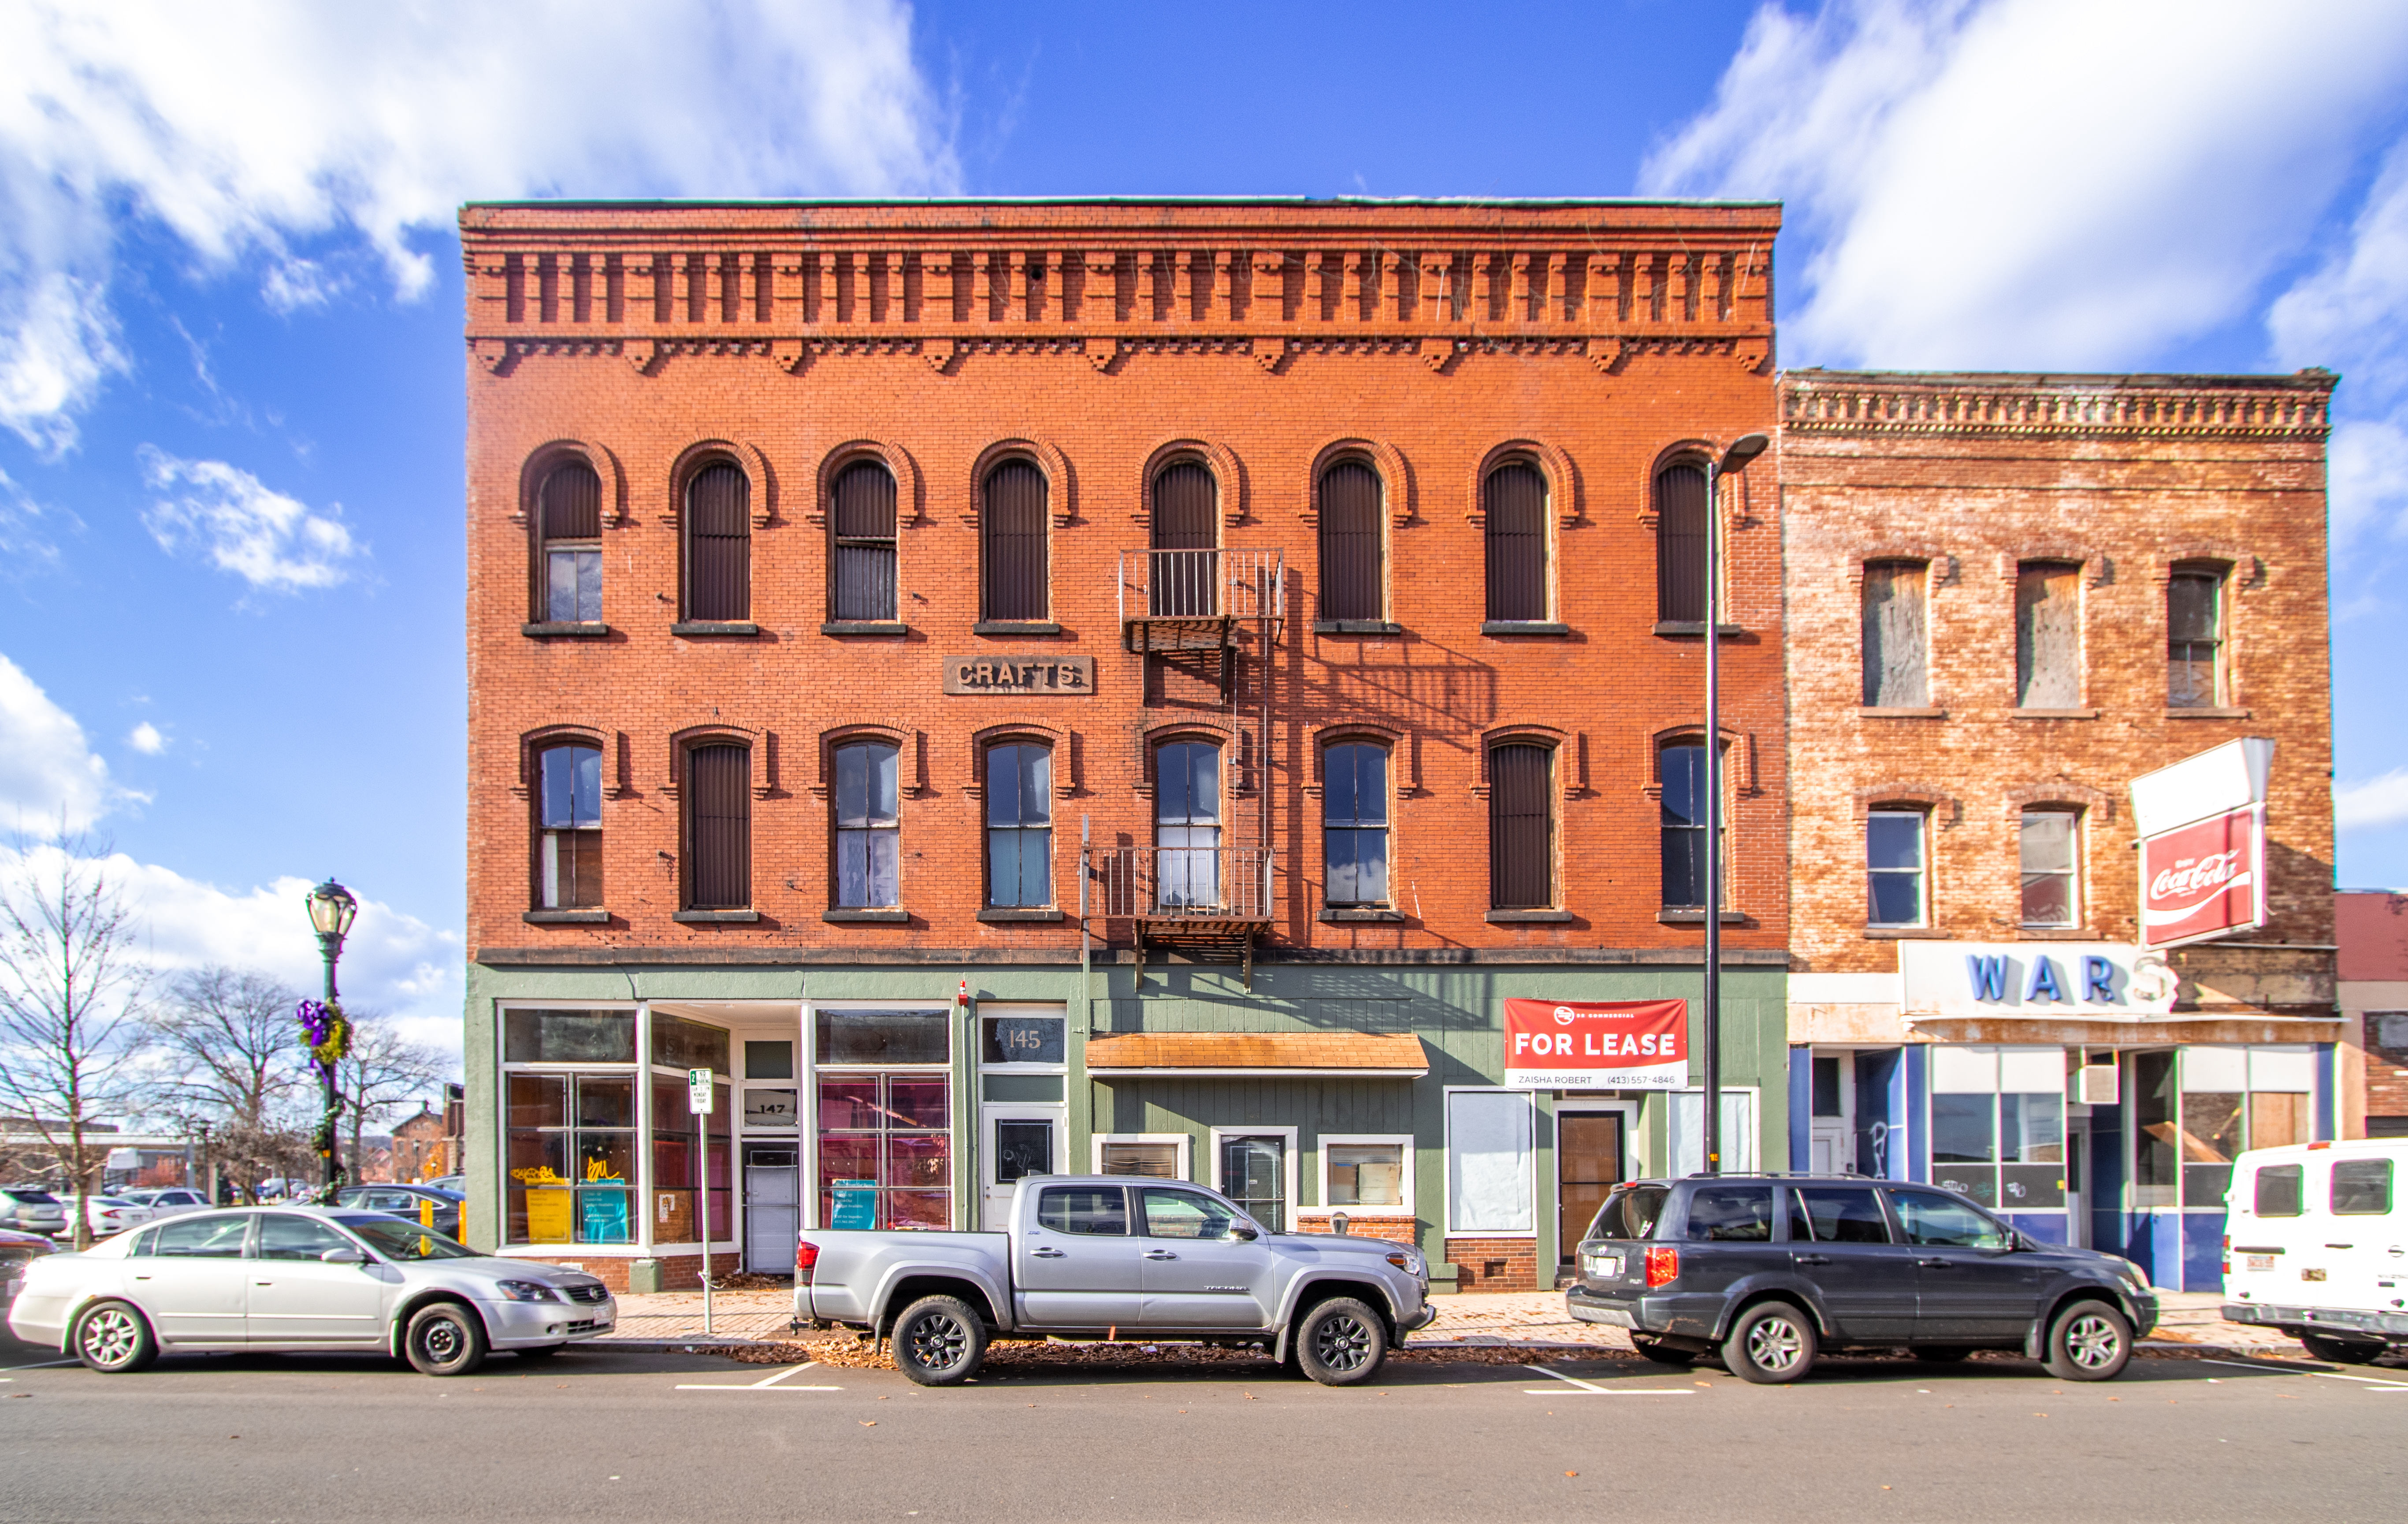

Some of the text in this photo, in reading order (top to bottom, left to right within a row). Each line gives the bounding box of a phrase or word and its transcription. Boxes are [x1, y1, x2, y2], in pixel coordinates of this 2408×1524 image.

[1010, 1030, 1041, 1048] 145
[1515, 1033, 1676, 1056] FOR LEASE
[691, 1074, 695, 1082] 2
[760, 1104, 785, 1113] 147
